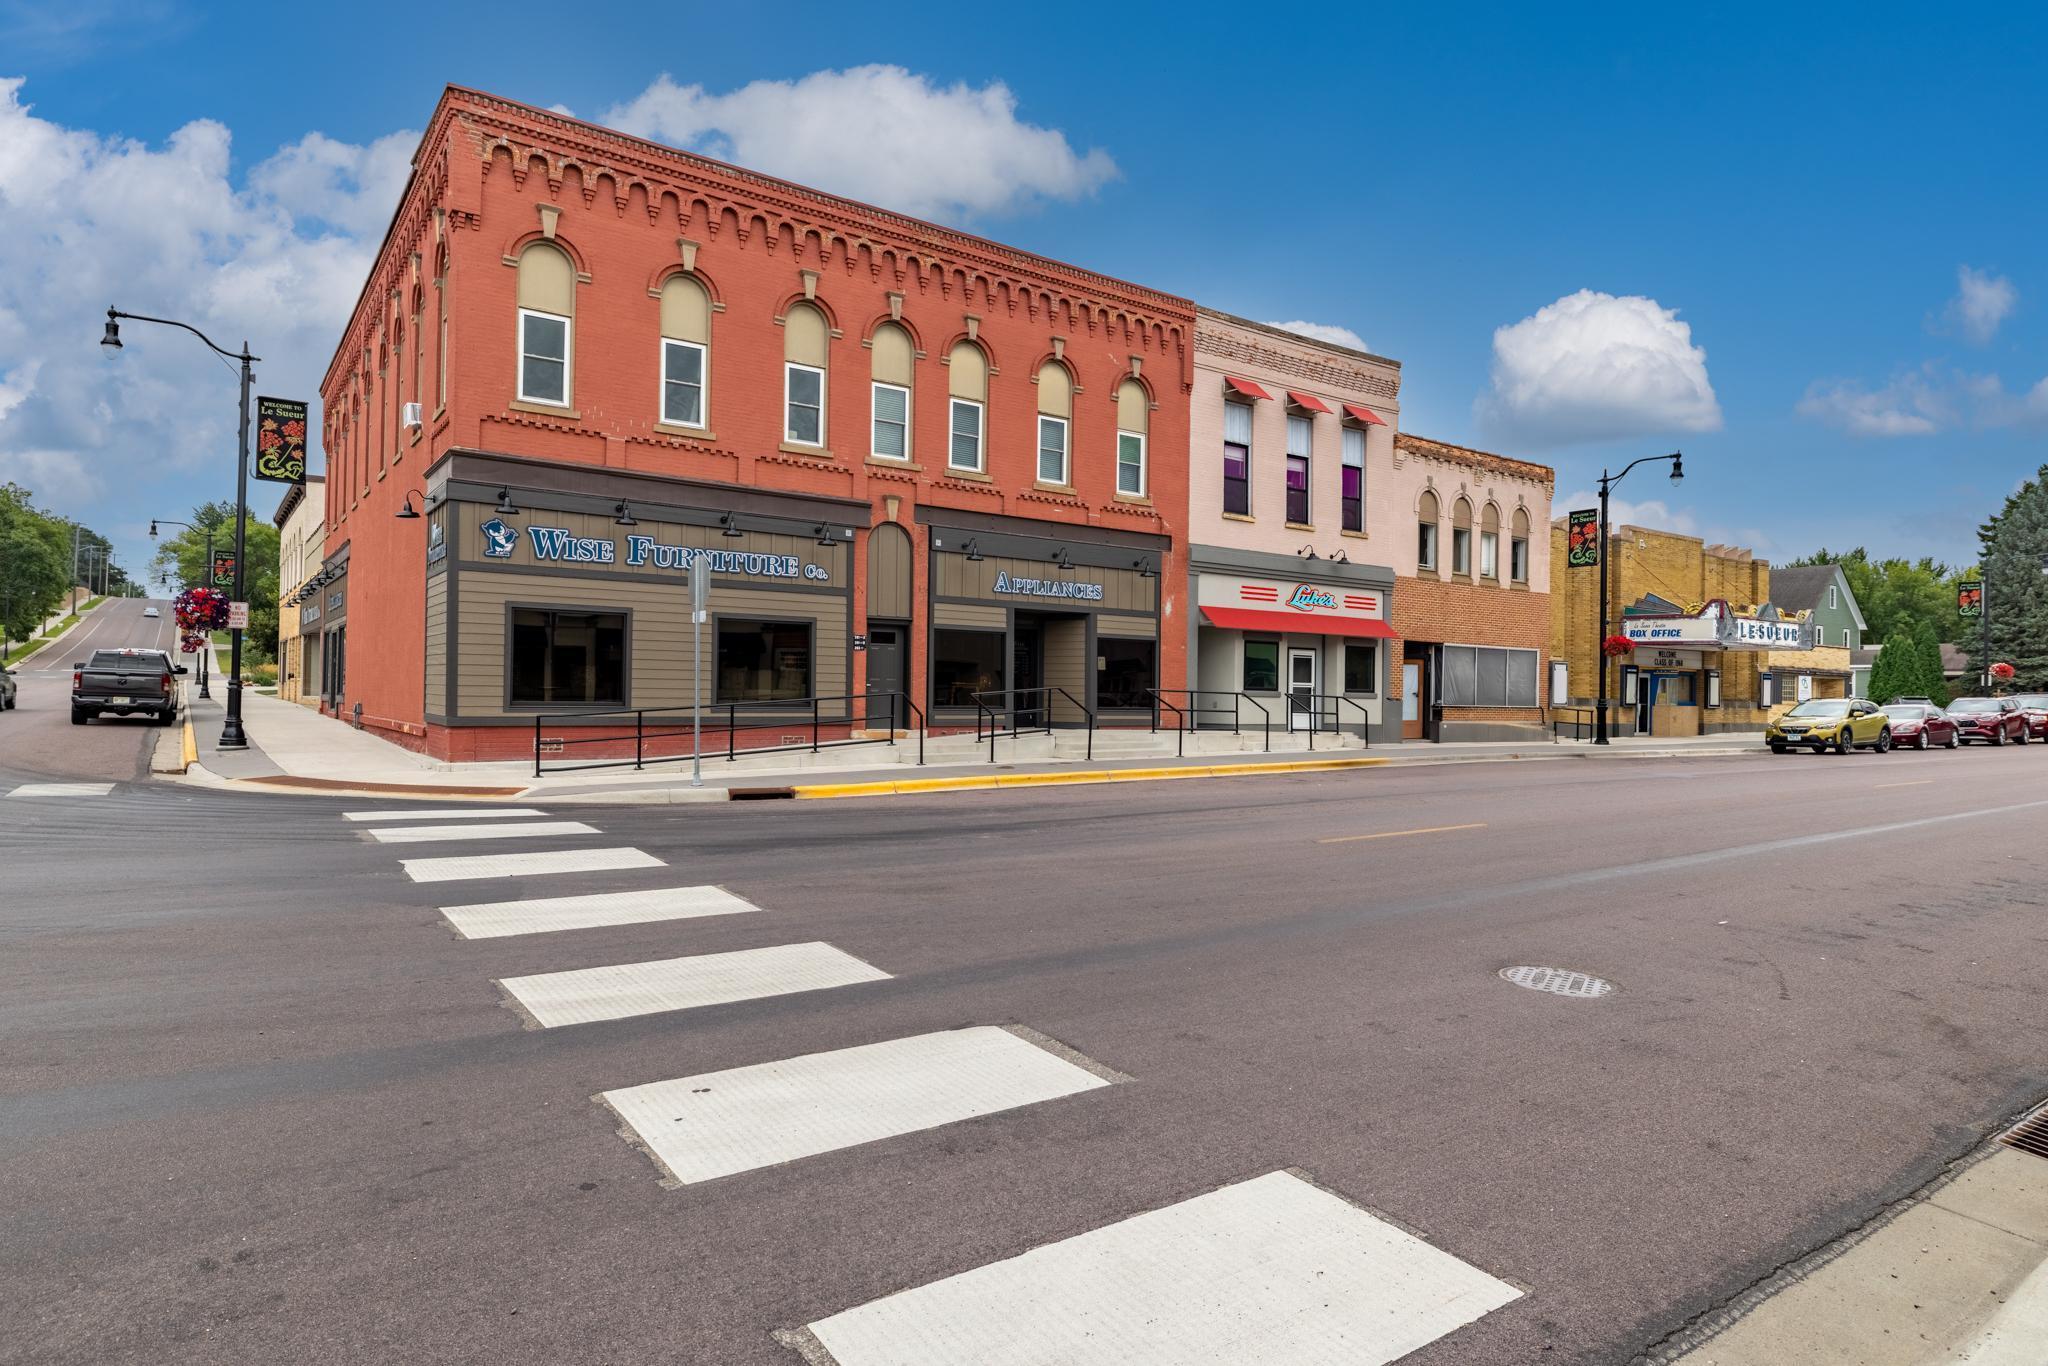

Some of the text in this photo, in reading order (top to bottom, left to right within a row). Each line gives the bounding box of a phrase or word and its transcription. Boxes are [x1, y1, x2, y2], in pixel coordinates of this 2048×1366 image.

[263, 401, 293, 410] WELCOME
[261, 406, 305, 419] Le Sueur
[528, 526, 614, 563] WISE
[994, 571, 1103, 600] APPLIANCES
[1286, 583, 1338, 611] Luke's
[1629, 629, 1683, 638] BOX OFFICE
[1658, 650, 1677, 658] WELCOME
[1654, 658, 1667, 666] CLASS
